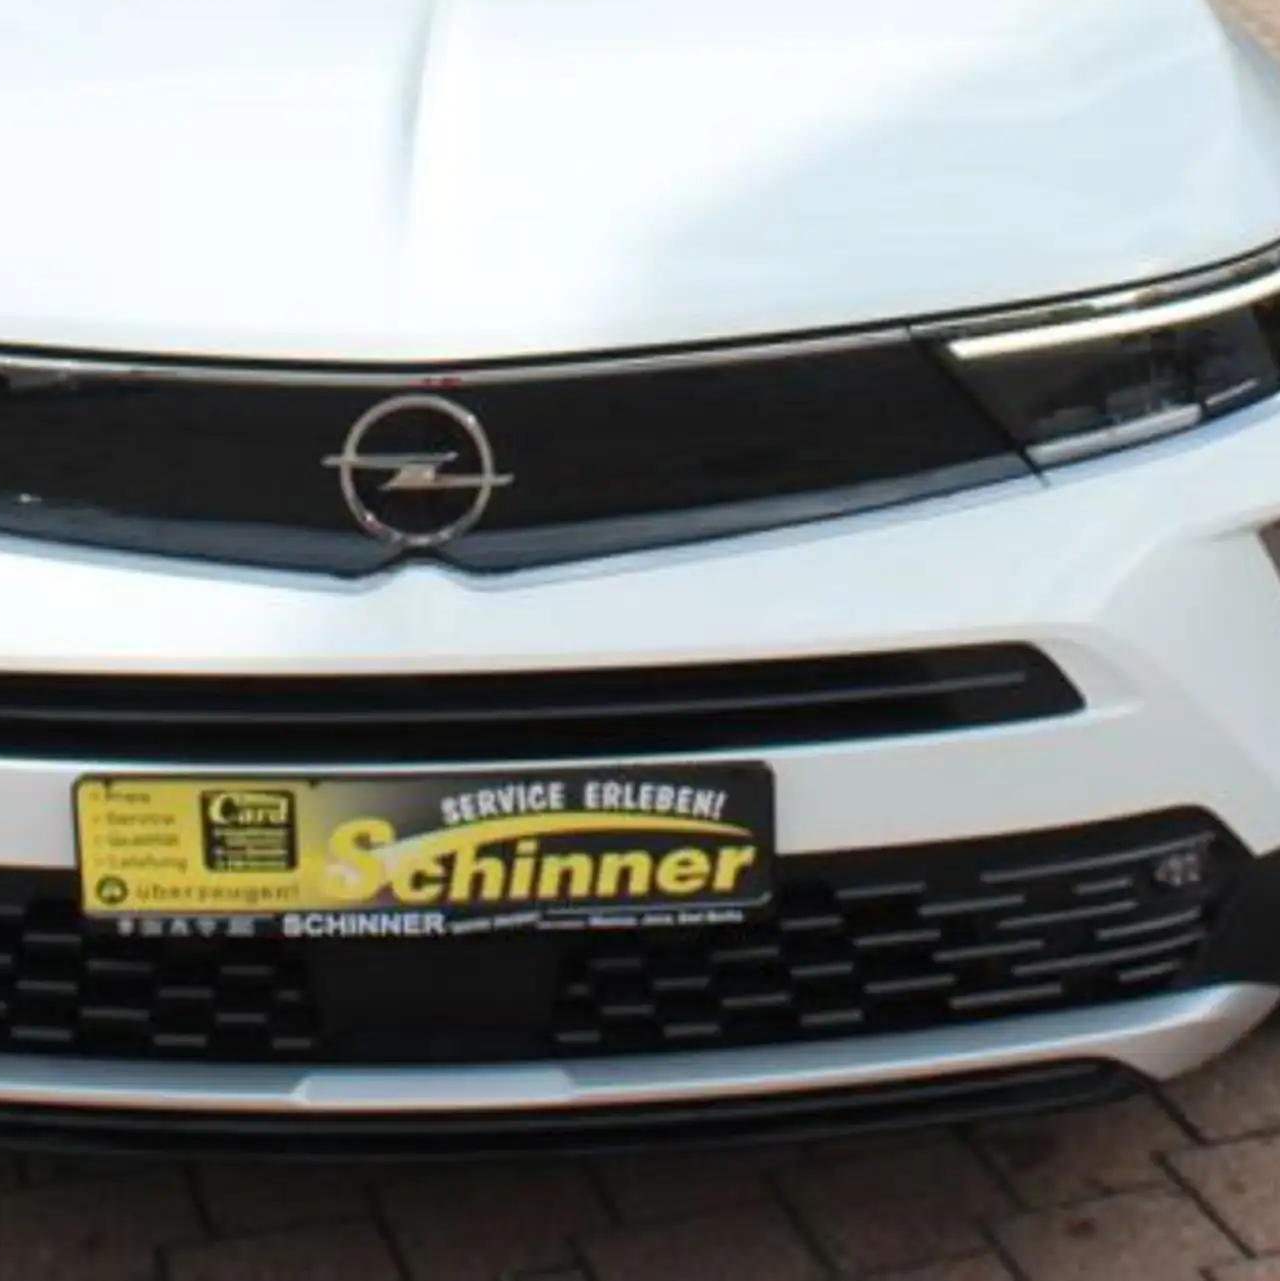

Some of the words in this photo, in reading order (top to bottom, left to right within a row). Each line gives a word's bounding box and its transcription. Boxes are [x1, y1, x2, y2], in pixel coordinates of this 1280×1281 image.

[441, 781, 566, 824] SERVICE
[583, 781, 730, 821] ERLEBEN!
[325, 817, 758, 903] Schinner
[282, 911, 446, 937] SCHINNER
